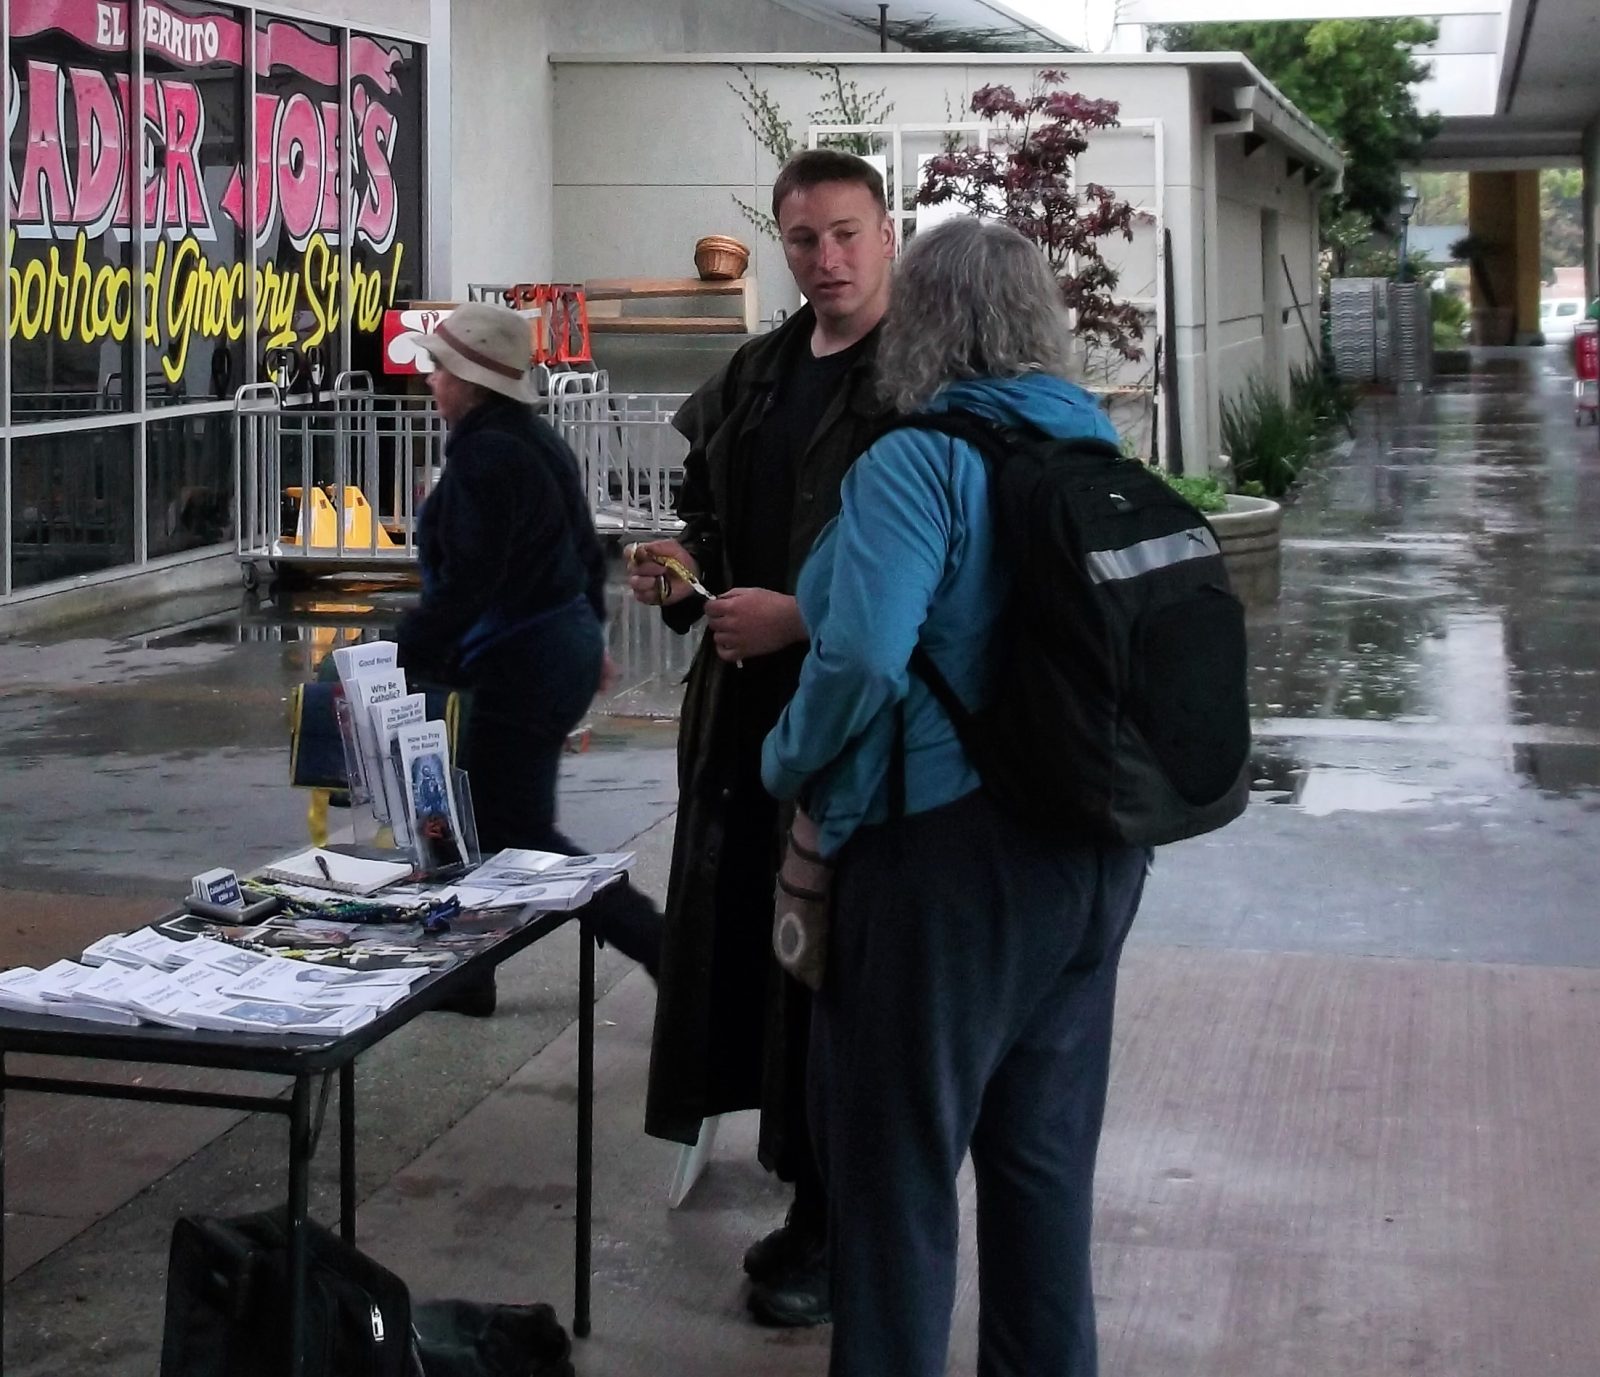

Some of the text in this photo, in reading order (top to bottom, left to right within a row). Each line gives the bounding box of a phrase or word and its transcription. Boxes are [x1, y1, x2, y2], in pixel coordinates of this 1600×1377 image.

[97, 3, 125, 46] EL
[9, 60, 397, 244] ADER JOE'S
[359, 657, 375, 667] Good
[371, 681, 397, 693] Why Be
[370, 690, 400, 704] Catholic?
[428, 732, 440, 740] Pray
[421, 741, 439, 749] Rosary
